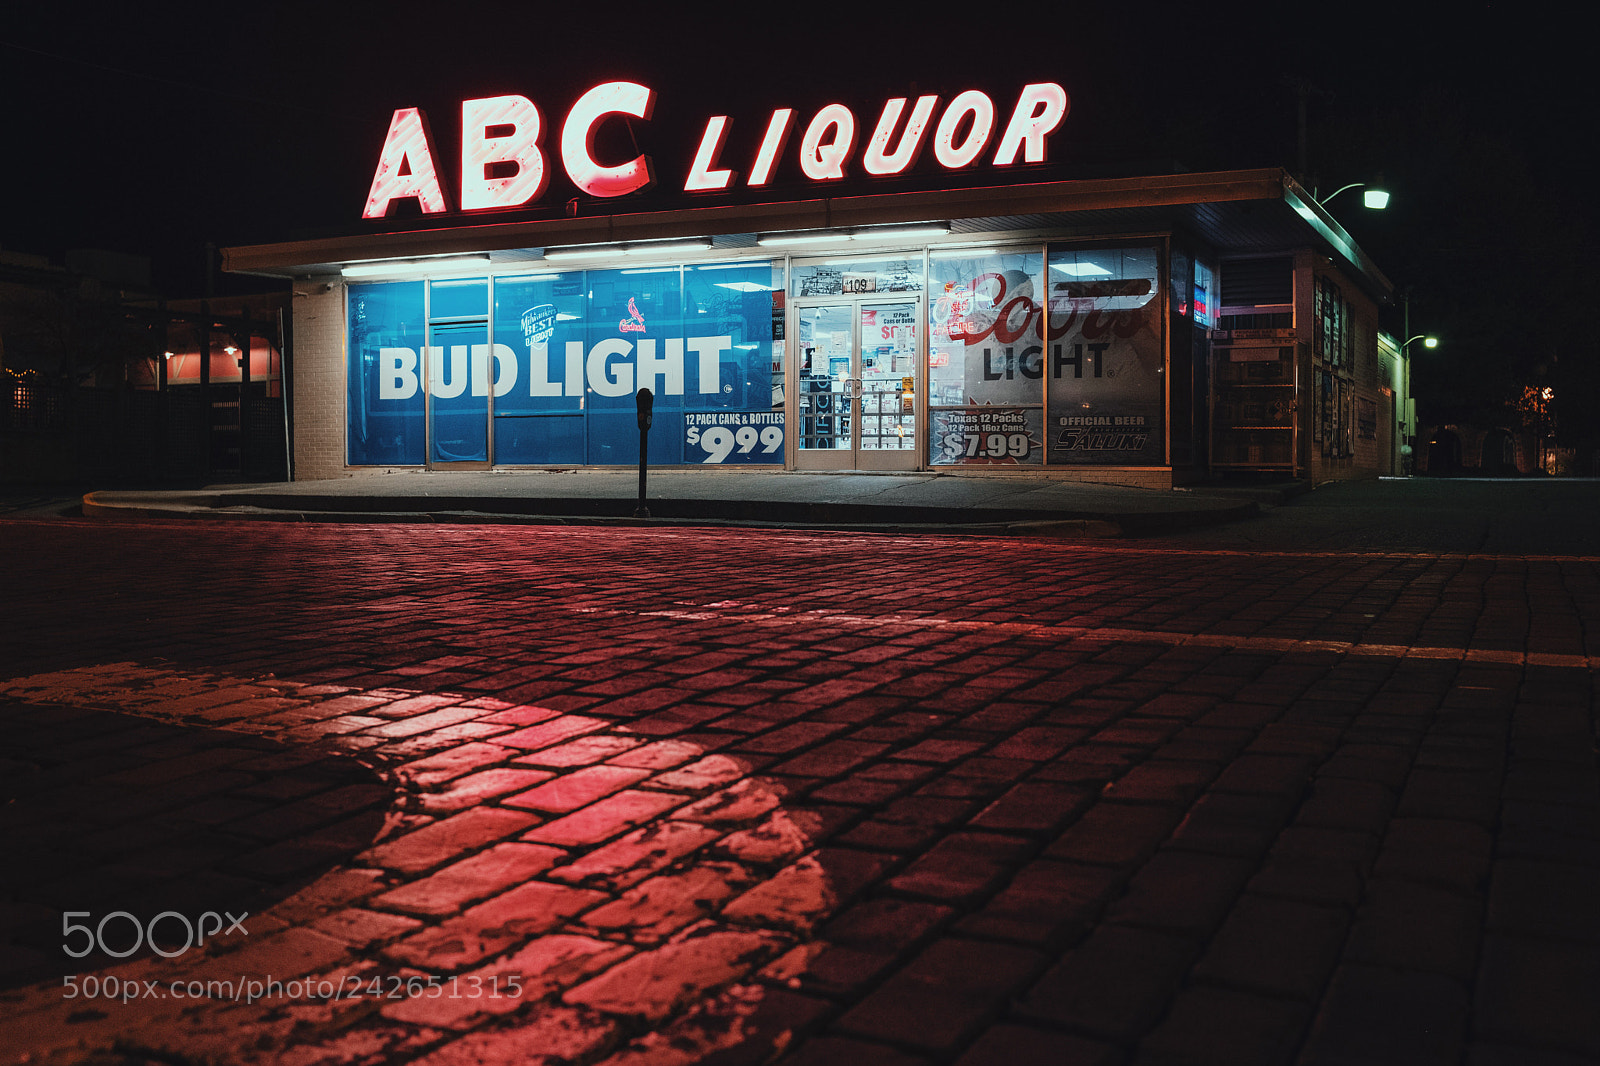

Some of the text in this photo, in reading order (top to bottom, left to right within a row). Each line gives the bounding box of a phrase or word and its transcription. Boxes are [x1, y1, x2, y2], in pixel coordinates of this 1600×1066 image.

[362, 82, 1068, 219] ABC LIQUOR
[849, 278, 867, 291] 109
[525, 316, 555, 336] BEST
[378, 335, 732, 400] BUD LIGHT
[984, 343, 1111, 381] LIGHT
[685, 412, 784, 425] 12 PACK CANS & BOTTLES
[949, 414, 1024, 423] Texas 12 Packs
[1060, 416, 1145, 426] OFFICIAL BEER
[948, 424, 1024, 432] 12 Pack 16oz Cans
[943, 433, 1028, 459] $7.99
